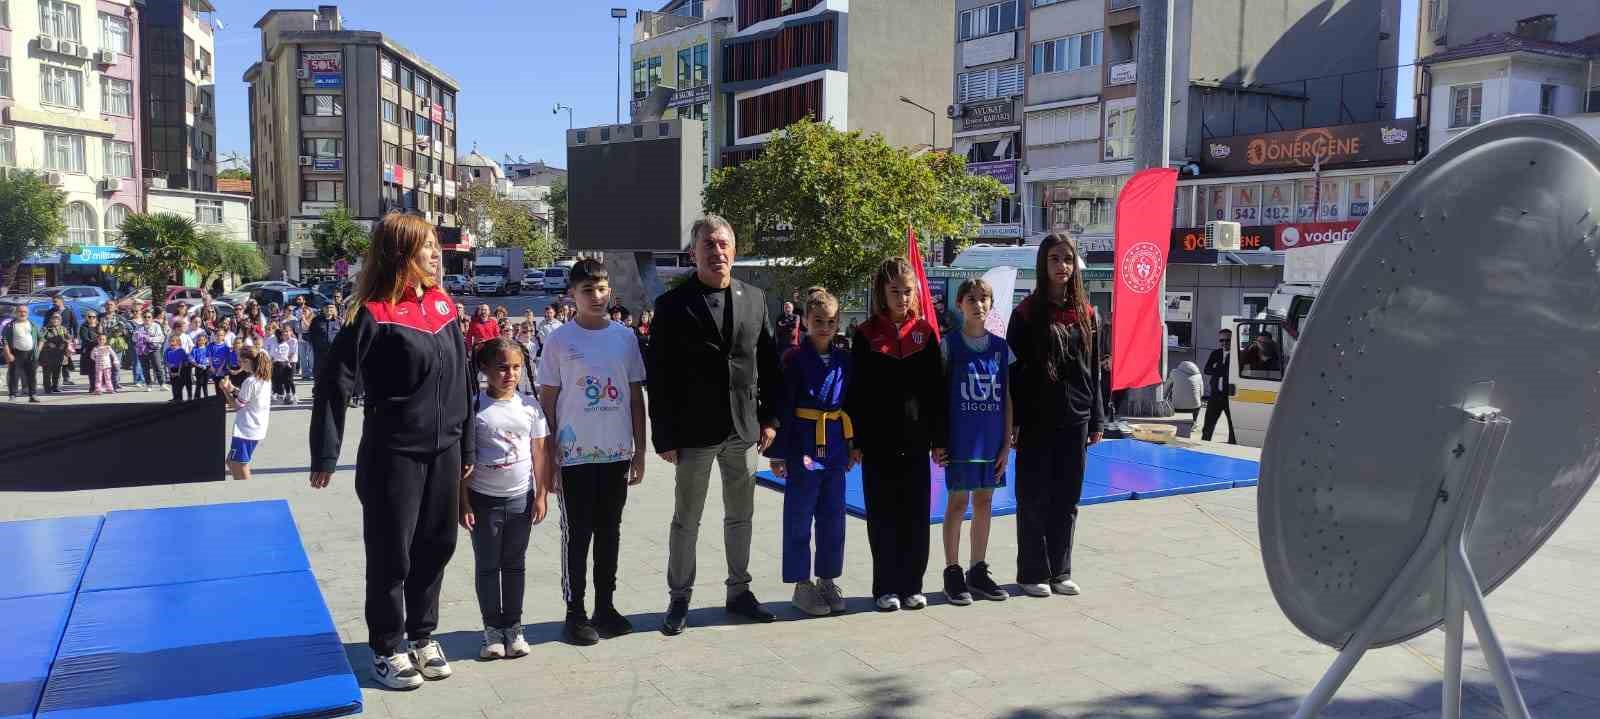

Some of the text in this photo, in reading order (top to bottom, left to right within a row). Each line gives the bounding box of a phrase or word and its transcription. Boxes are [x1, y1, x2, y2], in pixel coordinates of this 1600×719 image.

[1233, 208, 1256, 220] 542
[1264, 207, 1288, 219] 482
[1304, 228, 1354, 242] vodafo
